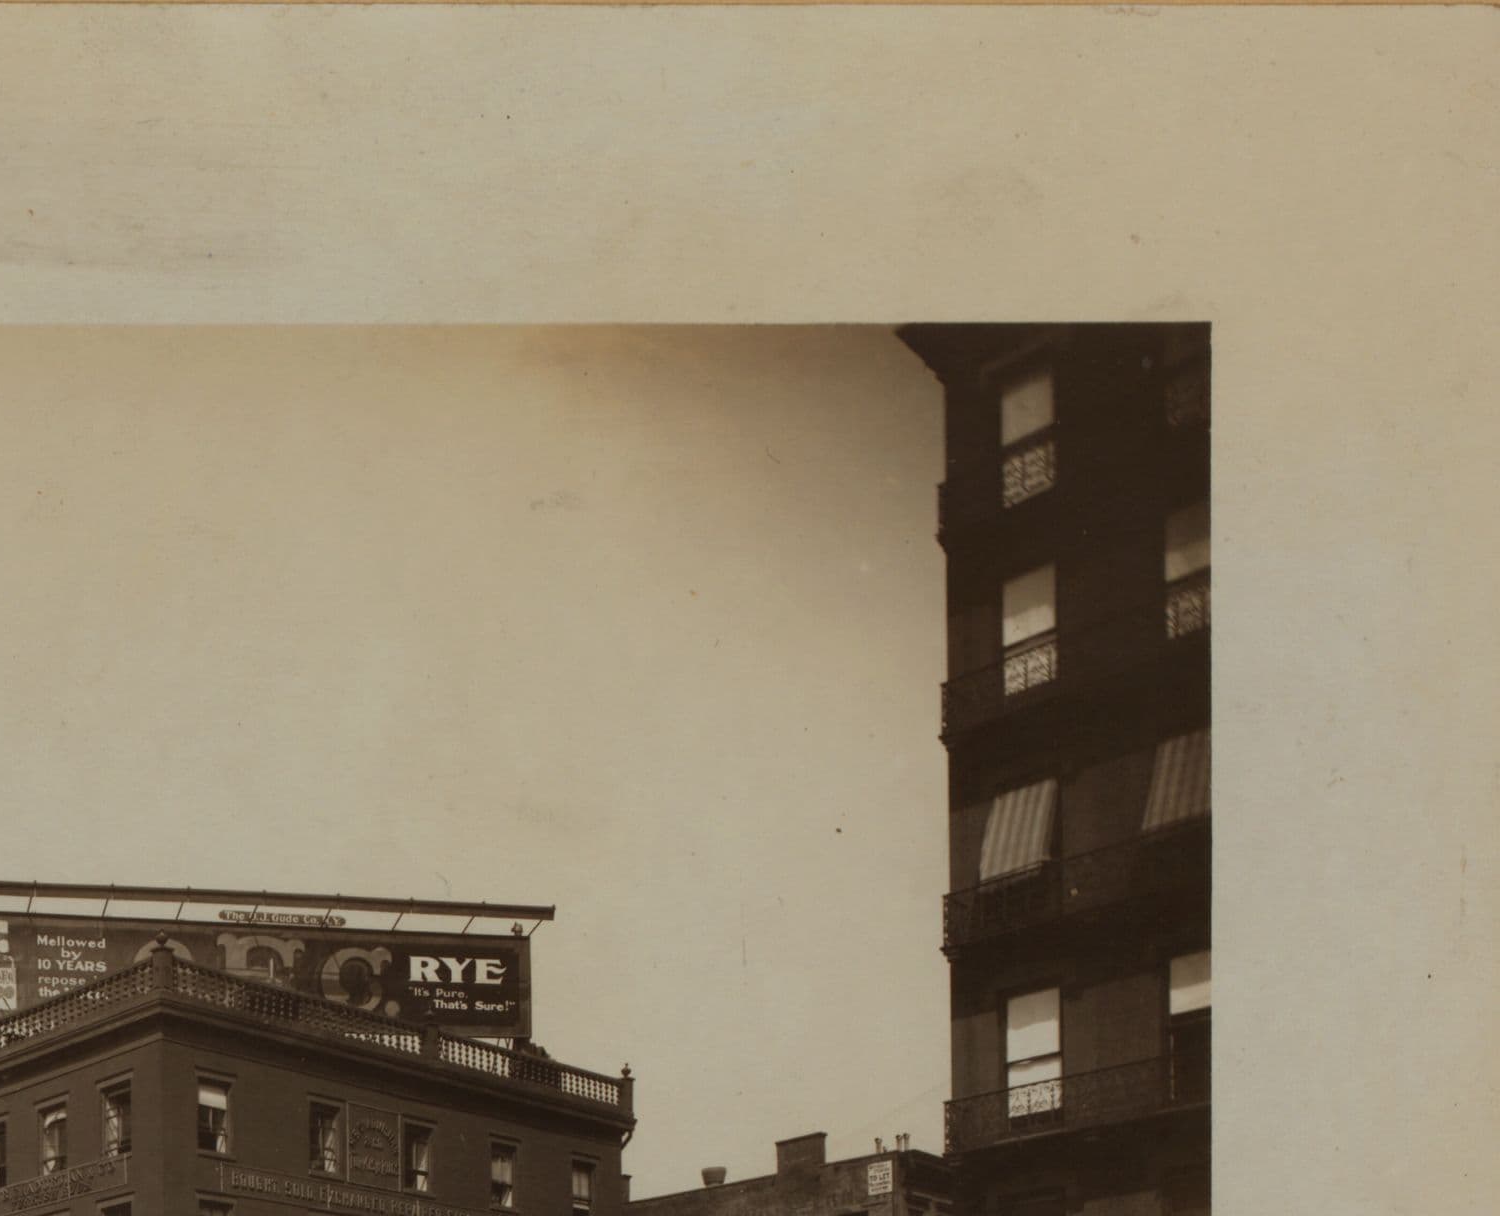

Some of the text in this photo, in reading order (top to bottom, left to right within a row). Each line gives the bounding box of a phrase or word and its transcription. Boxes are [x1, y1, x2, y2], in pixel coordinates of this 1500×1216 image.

[224, 911, 245, 920] The
[36, 933, 107, 949] Mellowed
[60, 947, 82, 960] by
[37, 957, 108, 974] 10 YEARS
[407, 955, 507, 985] RYE
[37, 976, 86, 987] repose
[38, 986, 60, 997] the
[435, 987, 469, 1000] Pure,
[433, 999, 468, 1011] That's
